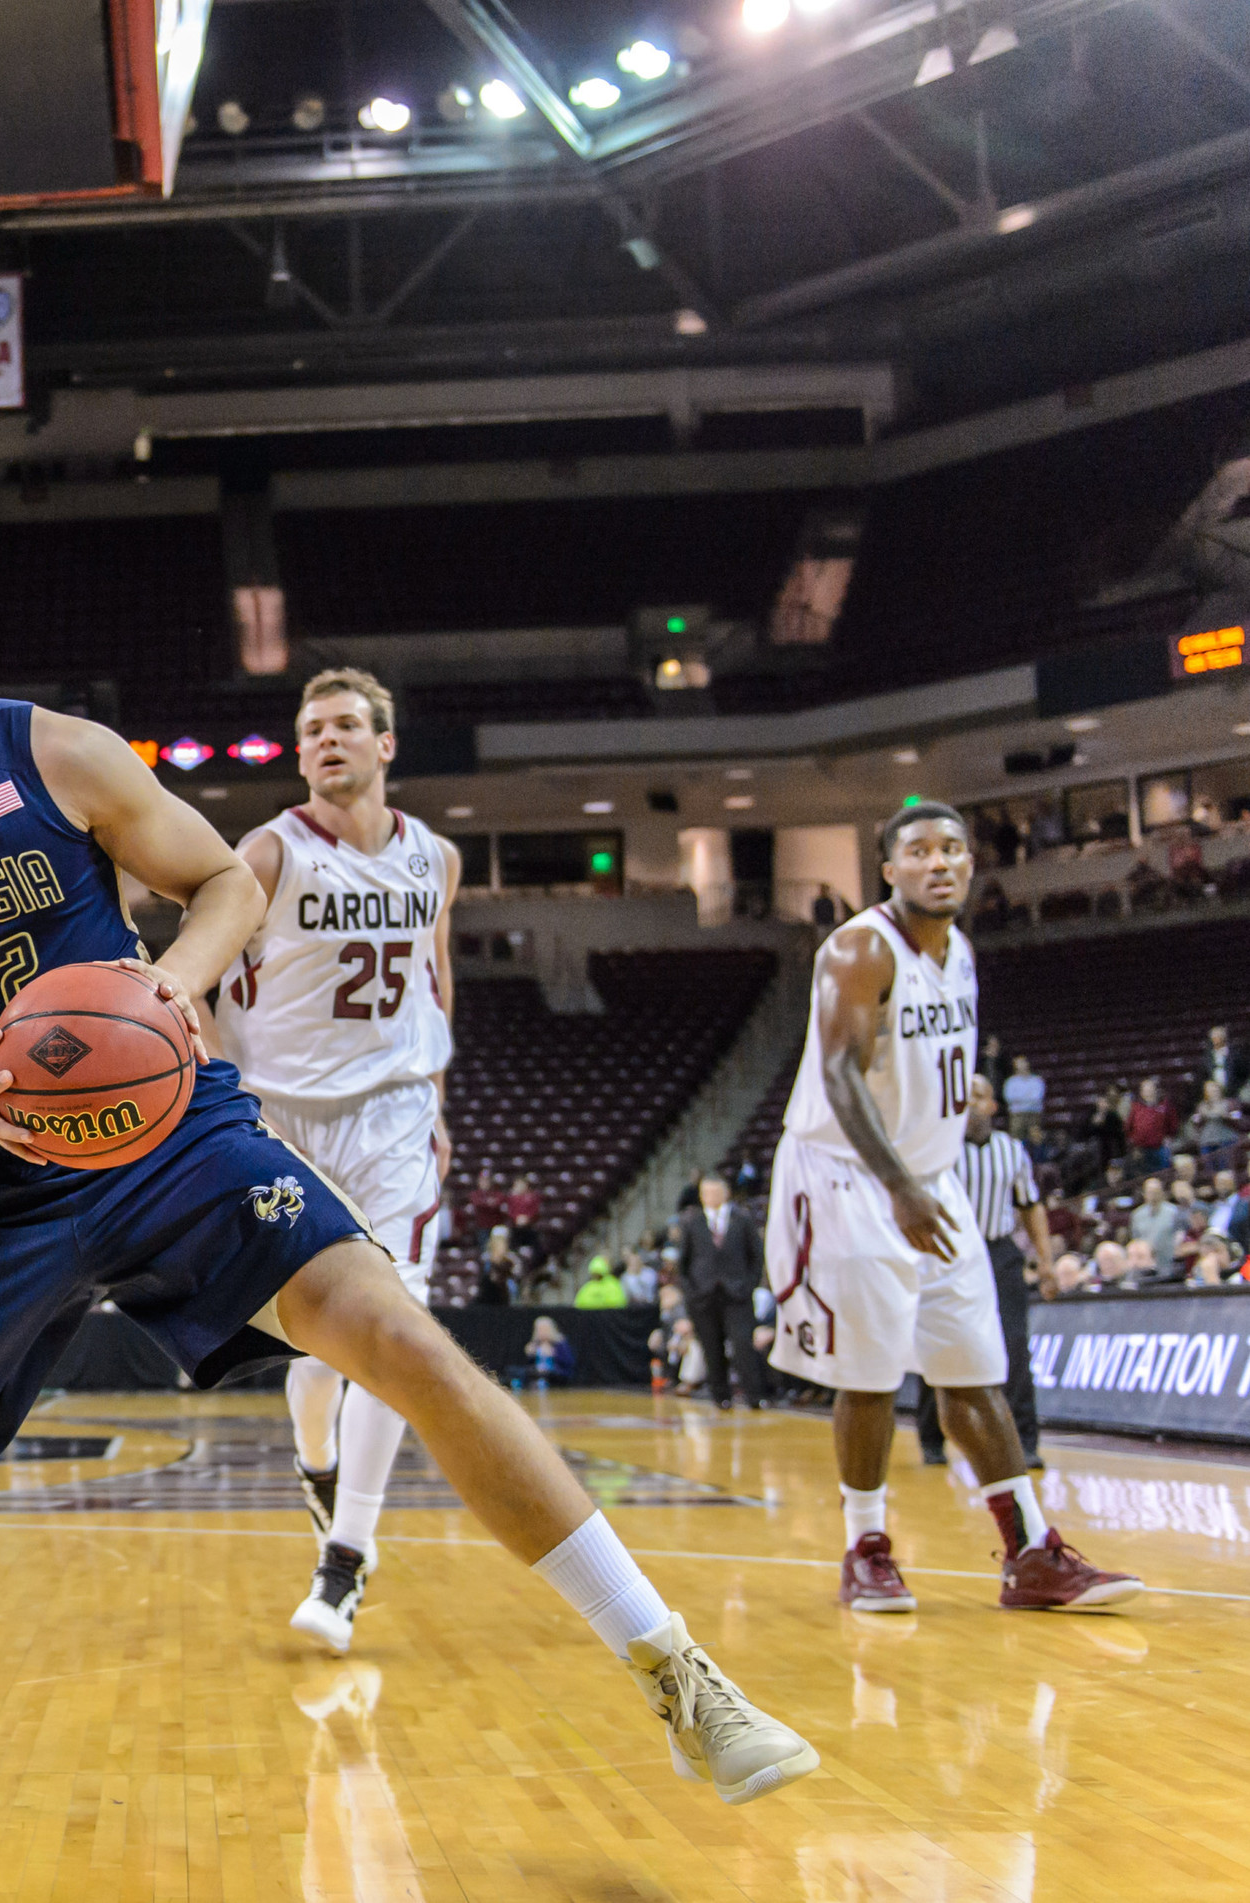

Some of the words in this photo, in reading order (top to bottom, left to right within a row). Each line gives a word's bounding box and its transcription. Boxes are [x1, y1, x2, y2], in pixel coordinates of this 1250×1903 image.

[332, 940, 414, 1021] 25
[901, 994, 977, 1039] CAROLIN
[937, 1046, 968, 1118] 10
[5, 1099, 147, 1145] Wilson
[1060, 1332, 1240, 1398] INVITATION
